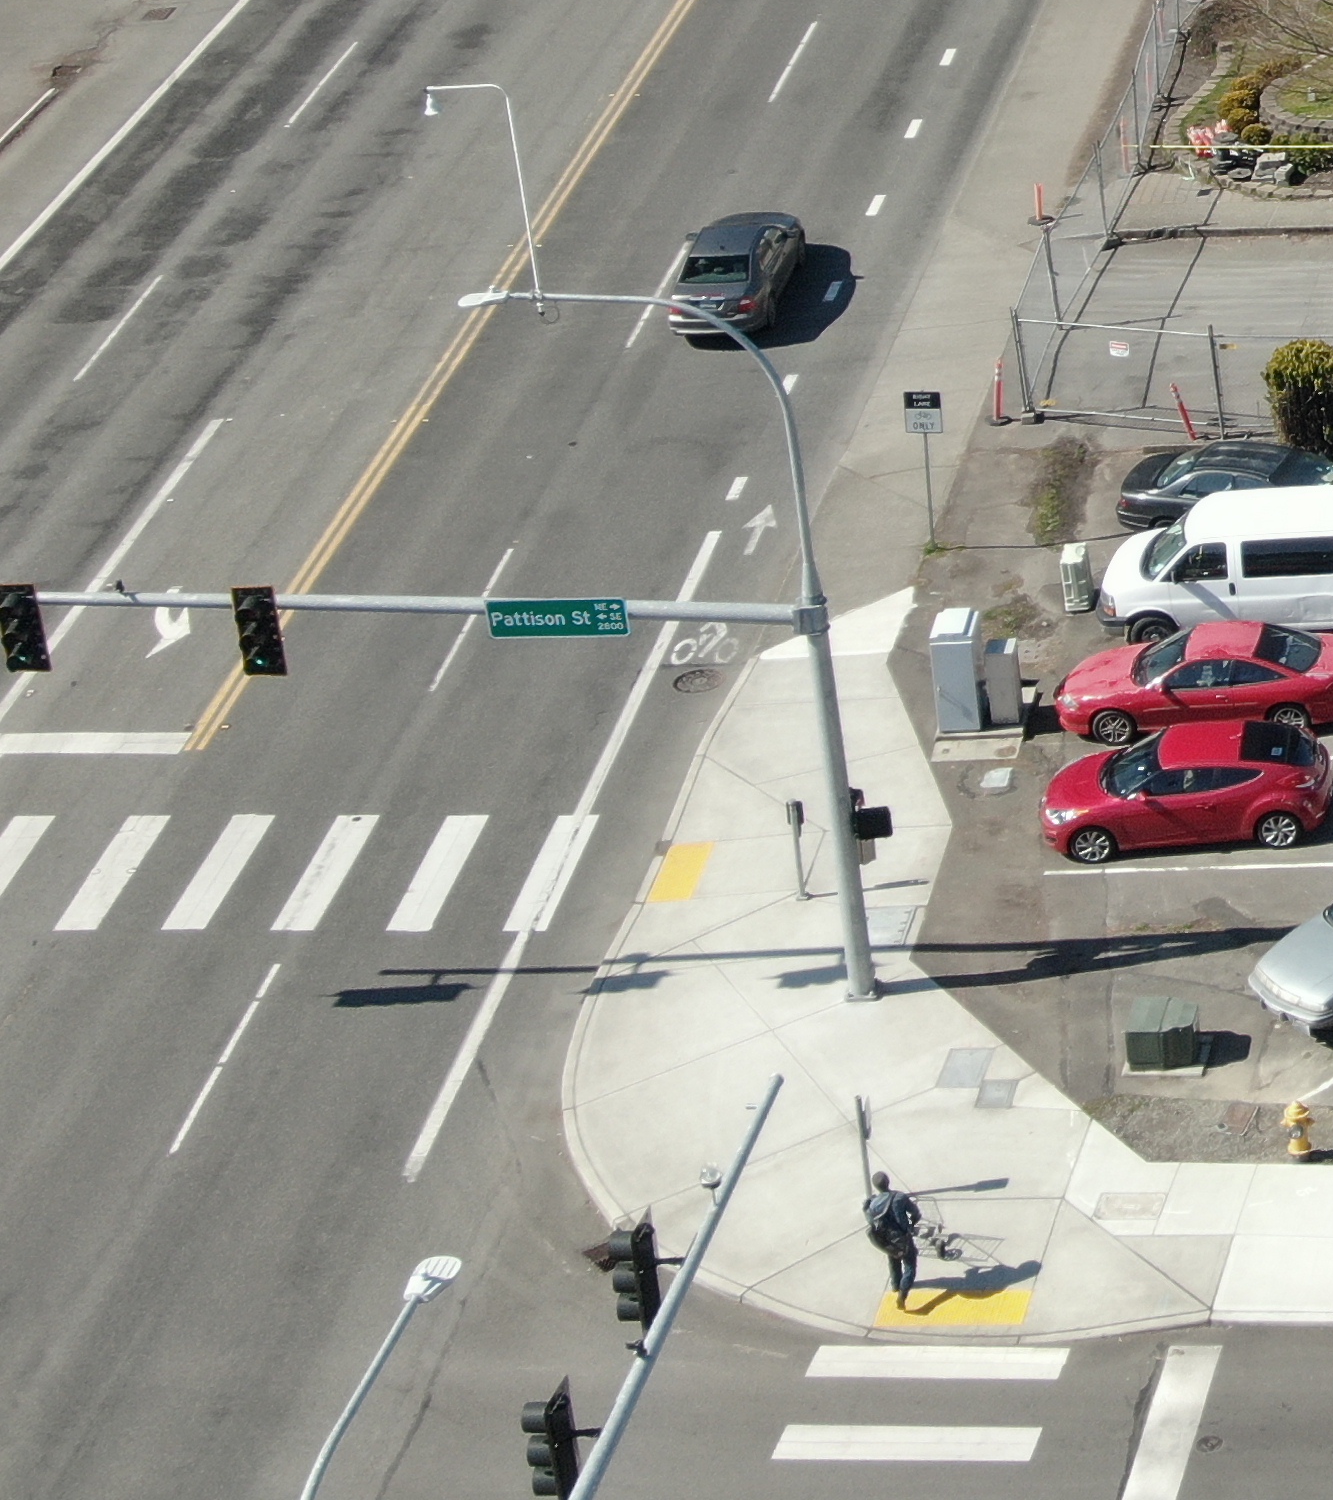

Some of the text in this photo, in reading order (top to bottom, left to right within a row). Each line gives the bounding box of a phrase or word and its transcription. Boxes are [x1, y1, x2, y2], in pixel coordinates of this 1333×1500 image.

[912, 421, 935, 430] ONLY
[490, 603, 608, 627] Pattison St NE
[609, 613, 622, 621] SE
